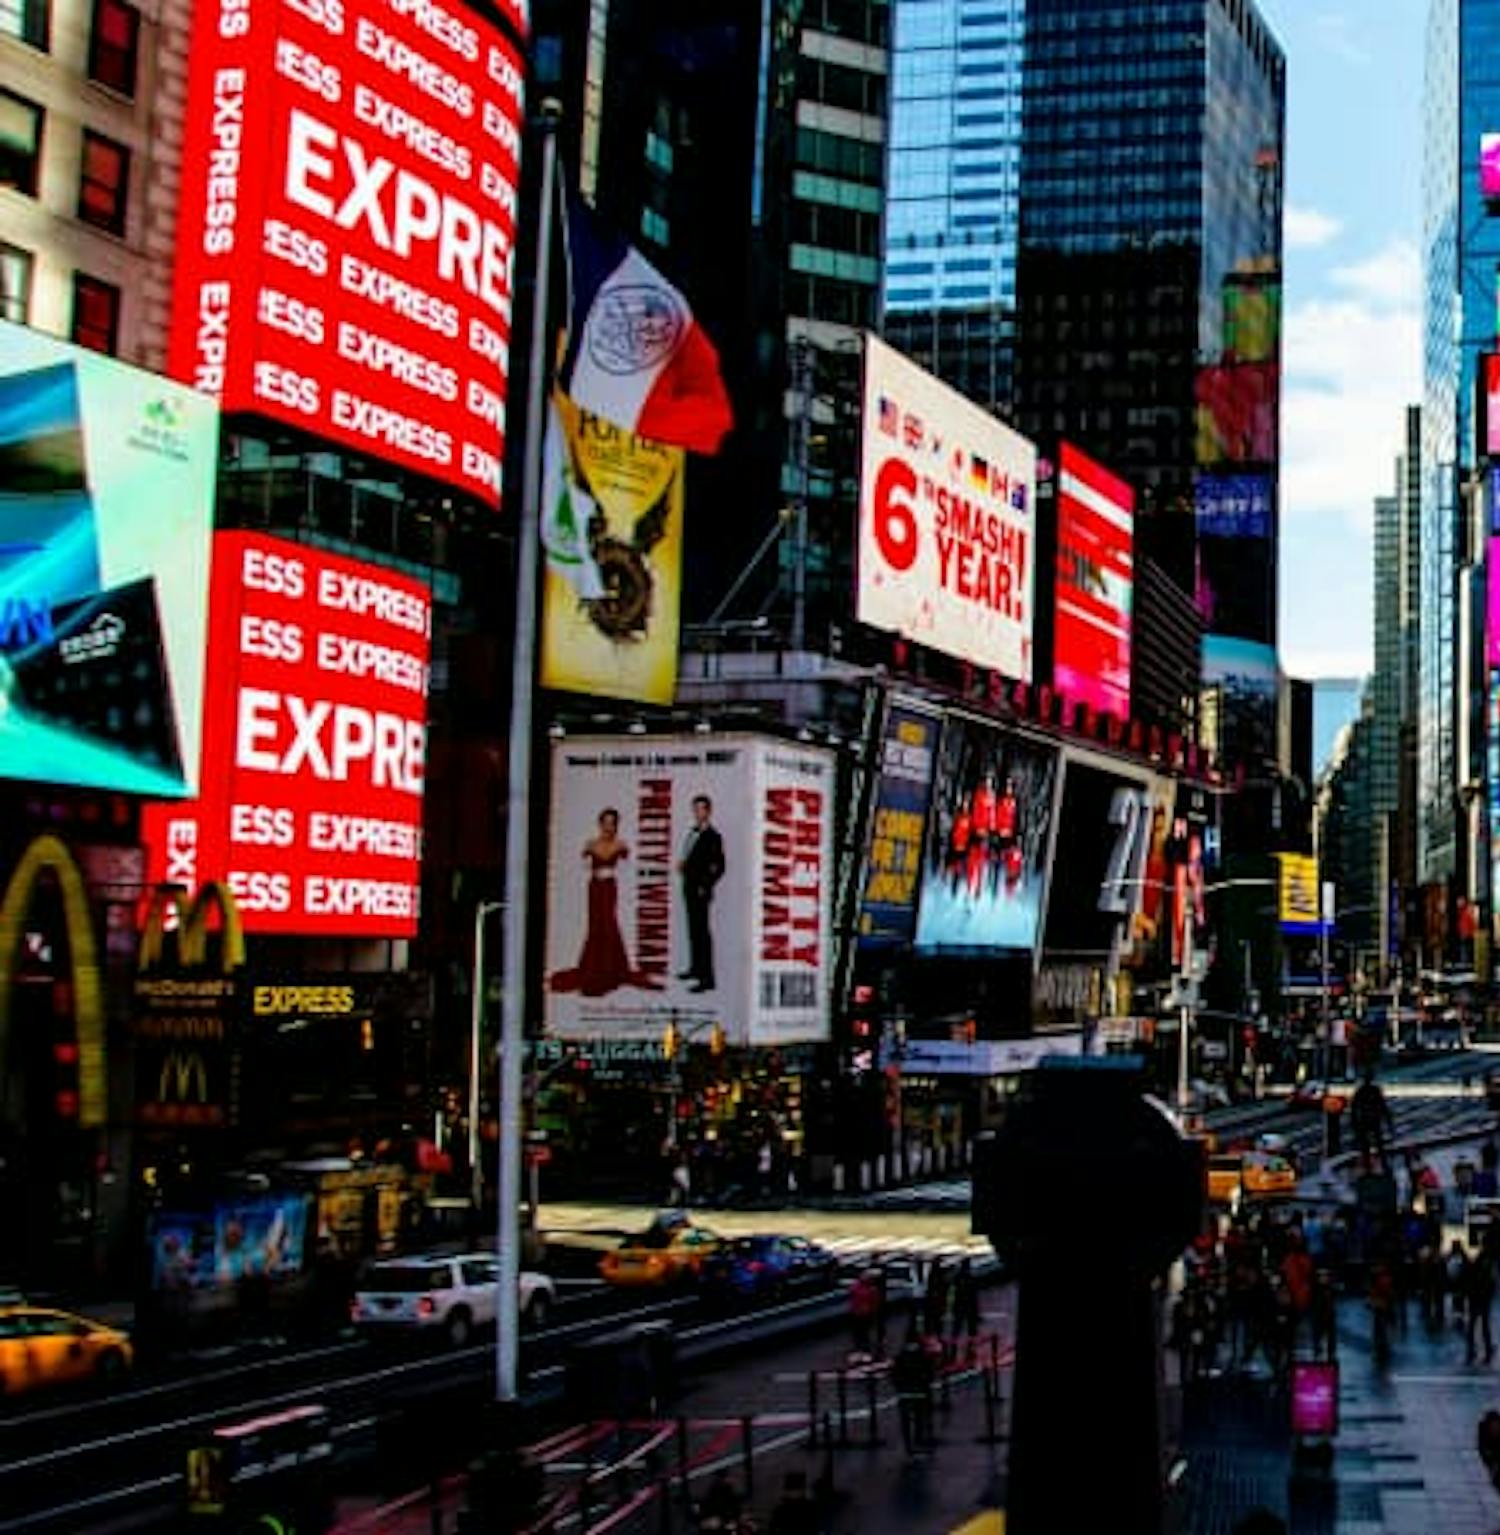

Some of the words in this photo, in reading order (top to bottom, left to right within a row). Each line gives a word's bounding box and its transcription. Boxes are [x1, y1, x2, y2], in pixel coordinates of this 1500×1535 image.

[275, 37, 342, 102] ESS
[355, 83, 472, 180] EXPRESS
[356, 17, 474, 116] EXPRESS
[204, 68, 246, 255] EXPRESS
[284, 107, 516, 328] EXPRE
[262, 218, 328, 277] ESS
[340, 253, 460, 339] EXPRESS
[256, 285, 325, 344] ESS
[337, 320, 459, 402] EXPRESS
[253, 360, 320, 416] ESS
[331, 389, 452, 466] EXPRESS
[637, 779, 672, 866] PRETTY
[762, 788, 796, 962] WOMAN
[789, 789, 823, 968] PRETTY
[636, 881, 670, 991] WOMAN
[253, 985, 355, 1016] EXPRESS
